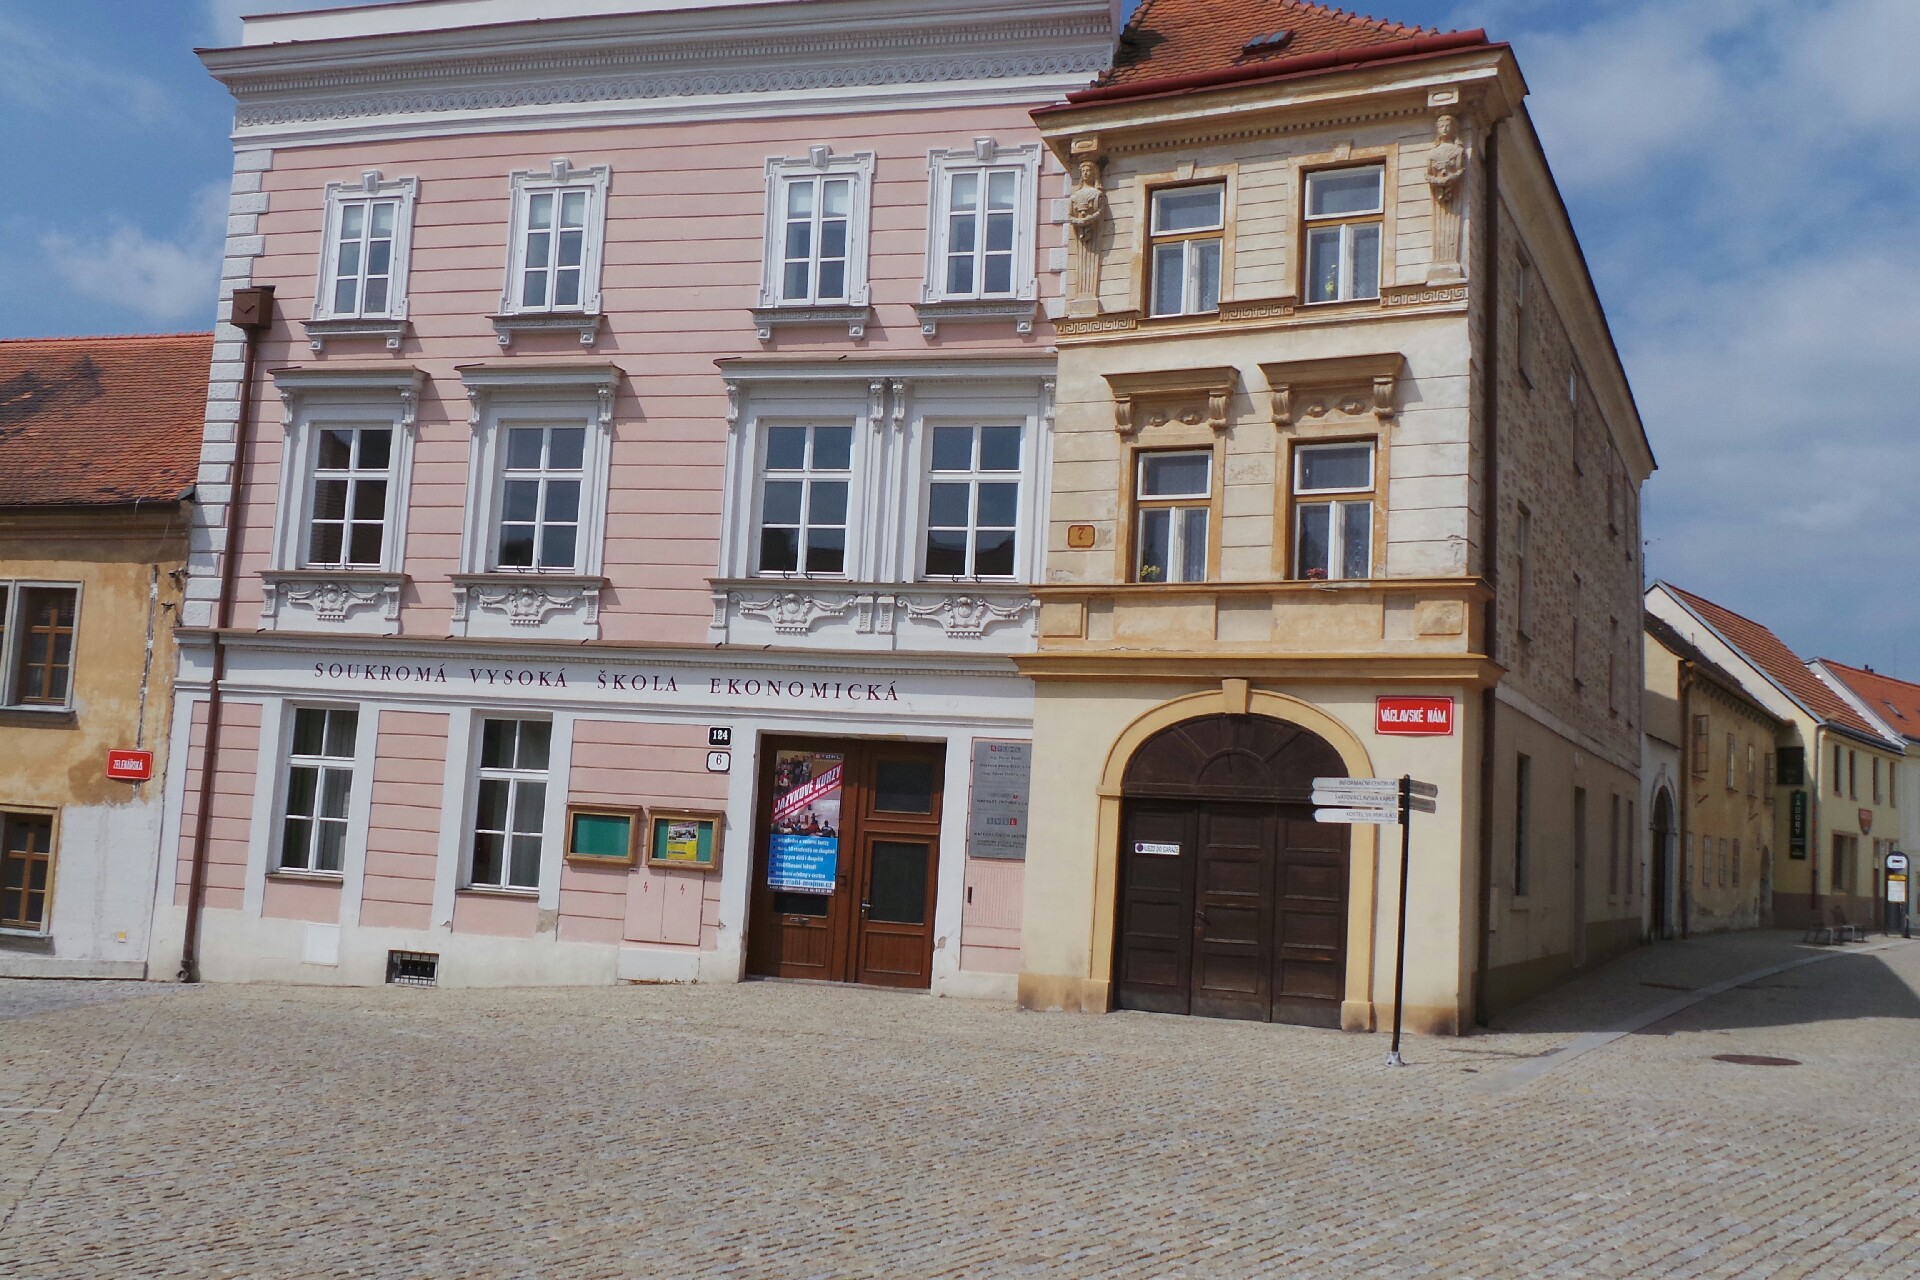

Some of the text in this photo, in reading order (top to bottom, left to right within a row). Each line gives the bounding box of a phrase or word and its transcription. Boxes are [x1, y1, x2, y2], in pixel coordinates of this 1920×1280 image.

[1077, 527, 1085, 540] 7
[315, 662, 898, 701] SOUKROMÁ VYSOKÁ ŠKOLA EKONOMICKÁ
[1380, 706, 1424, 722] VÁCLAVSKÉ
[712, 729, 728, 740] 124
[716, 754, 722, 765] 6
[774, 765, 841, 813] JAZYKOVÉ KURZY
